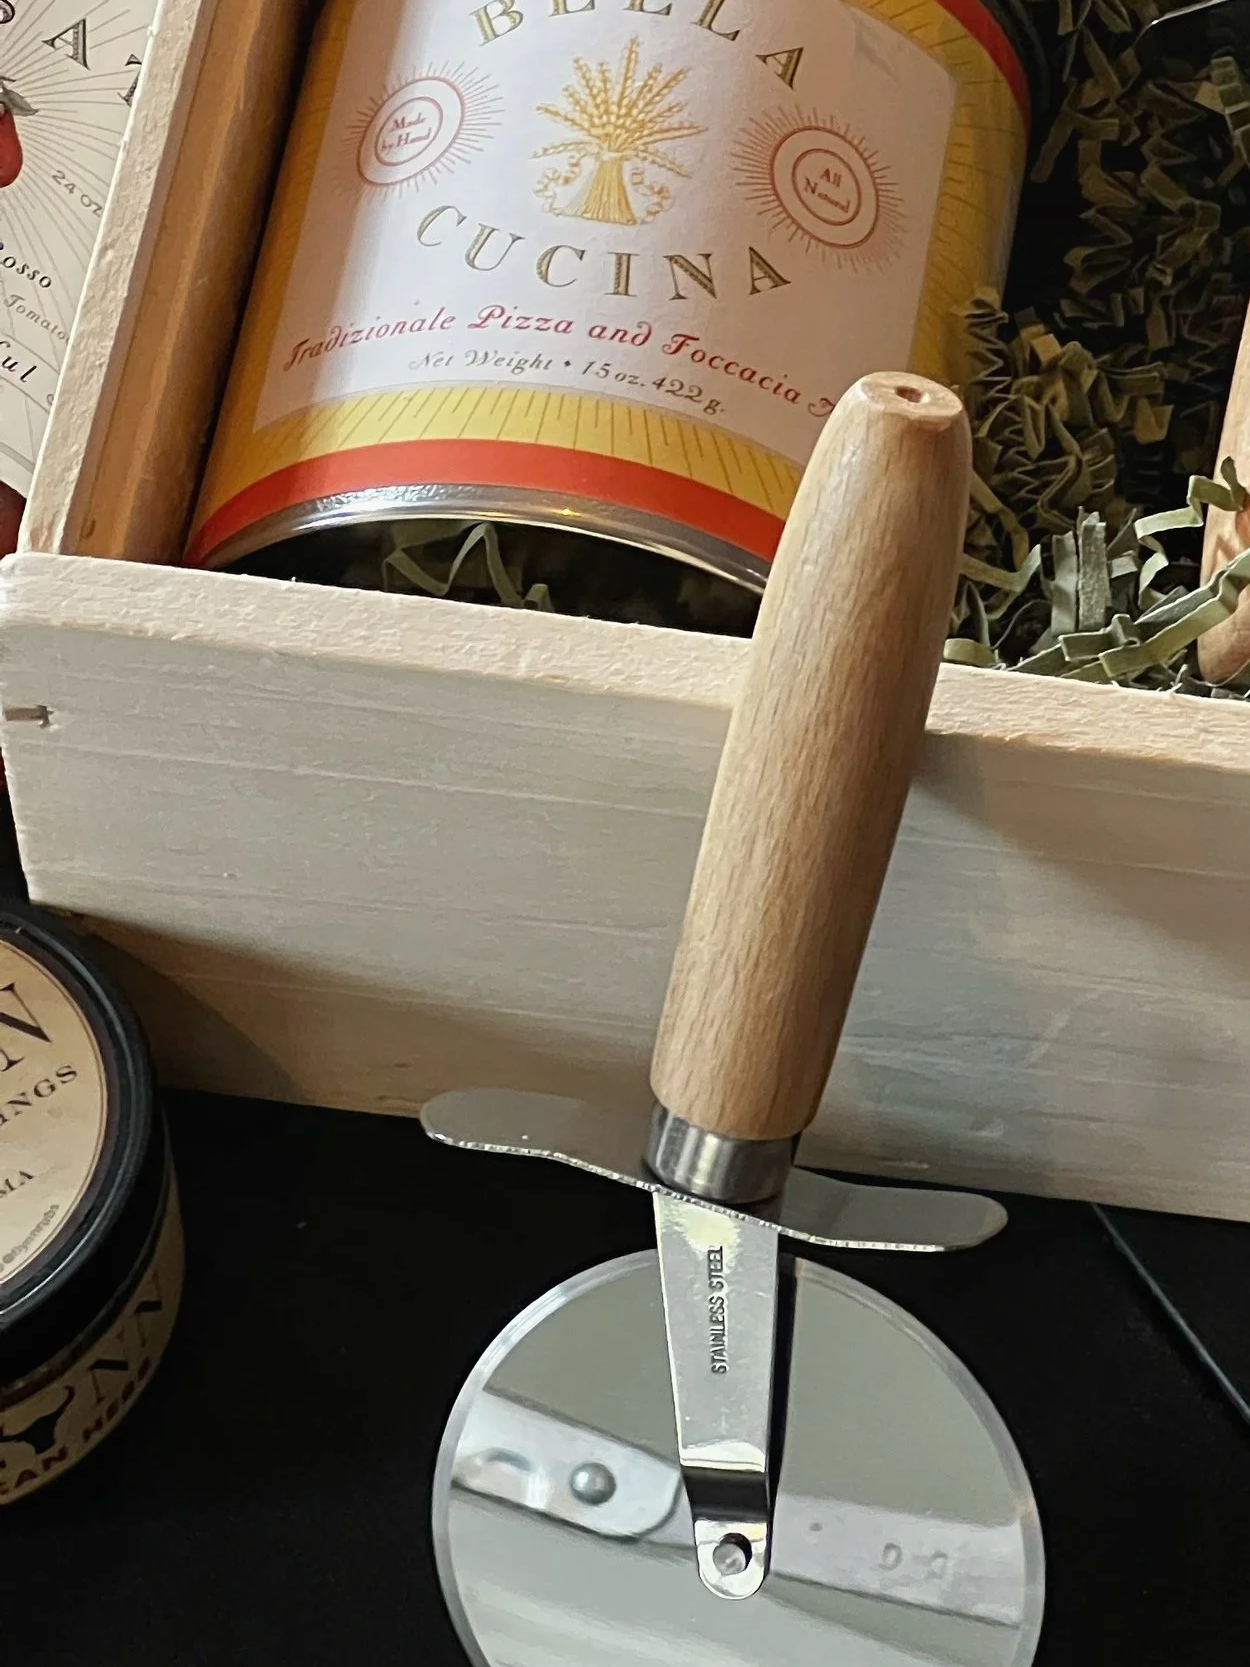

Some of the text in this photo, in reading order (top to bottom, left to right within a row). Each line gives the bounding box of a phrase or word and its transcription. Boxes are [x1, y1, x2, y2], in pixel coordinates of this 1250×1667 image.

[51, 169, 76, 195] 24
[0, 242, 52, 289] osso
[415, 205, 791, 300] CUCINA
[3, 294, 70, 346] Tomato
[283, 305, 802, 405] Tradizionale Pizza and Foccacia
[408, 351, 453, 370] Net
[464, 349, 553, 375] Weight
[709, 1295, 729, 1374] STAINLESS
